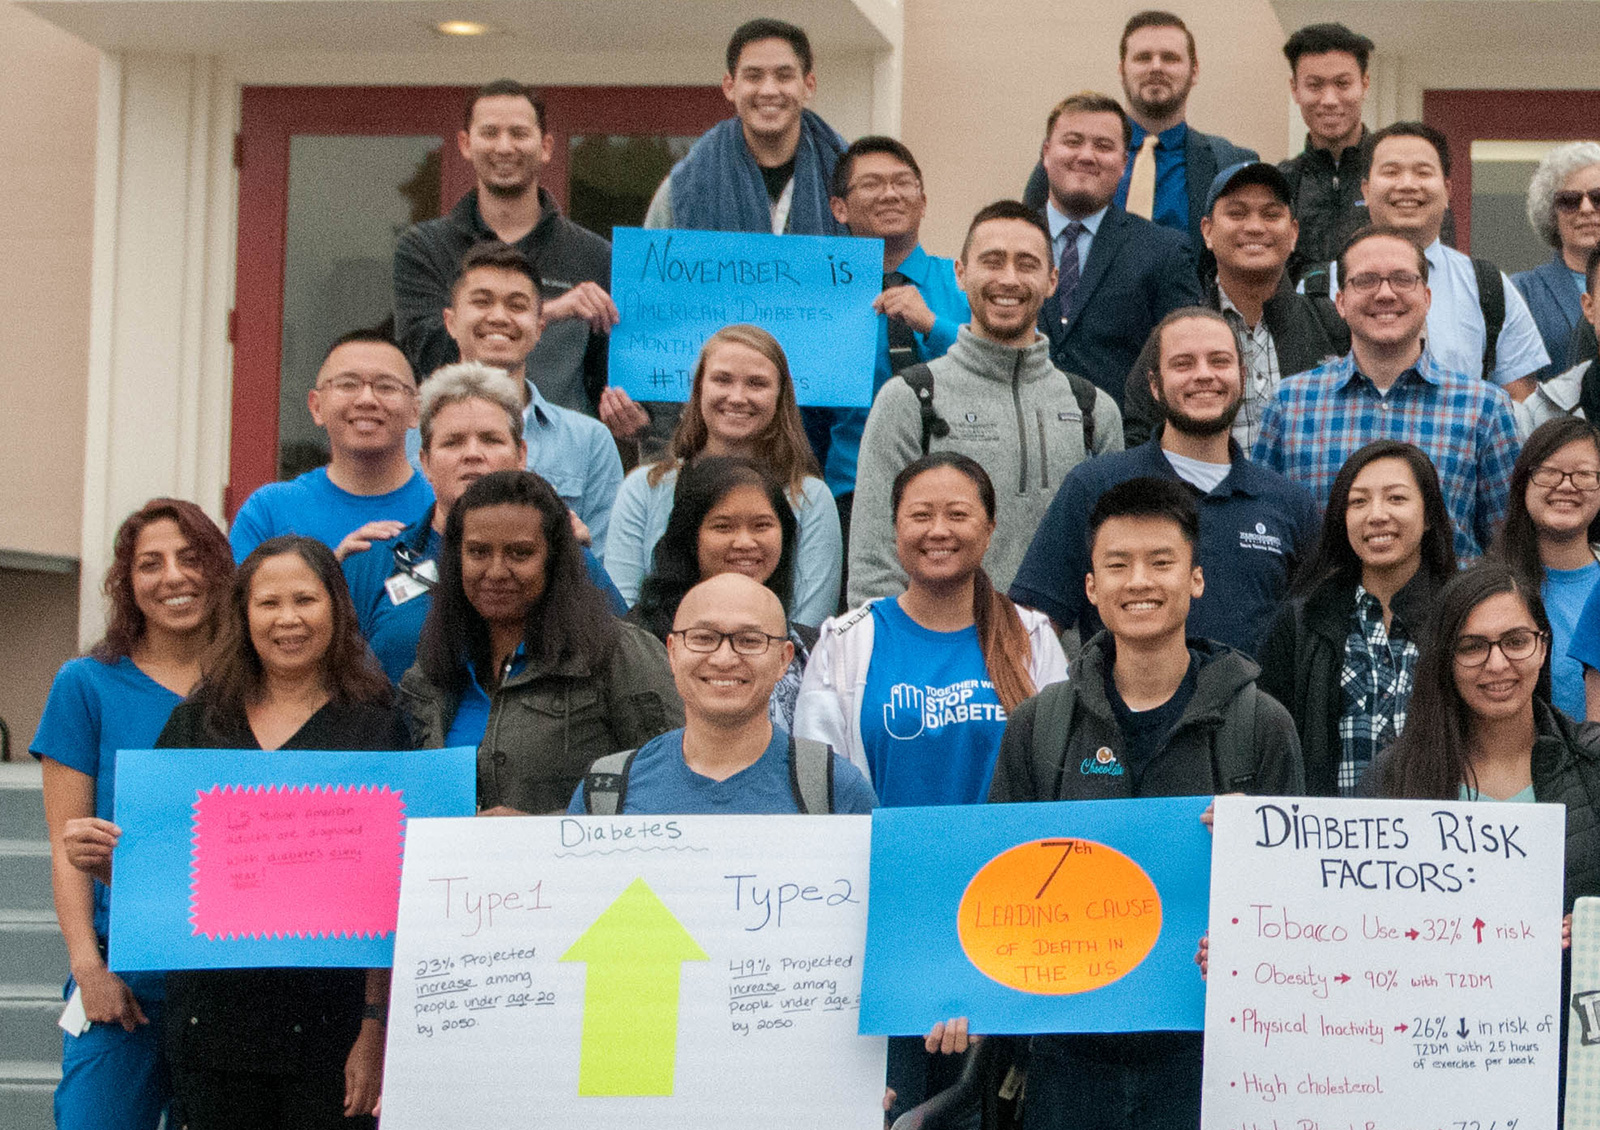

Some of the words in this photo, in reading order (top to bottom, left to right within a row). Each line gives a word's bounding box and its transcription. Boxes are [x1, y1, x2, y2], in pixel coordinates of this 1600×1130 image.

[641, 236, 801, 285] NOVEMBER
[828, 255, 853, 286] is
[623, 289, 727, 322] AMERICAN
[733, 296, 834, 323] DIABETES
[925, 679, 978, 697] TOGETHER
[926, 689, 973, 713] STOP
[926, 703, 1008, 729] DIABETE
[560, 818, 683, 848] Diabetes
[1320, 859, 1477, 893] FACTORS:
[975, 901, 1070, 928] LEADING
[1086, 898, 1155, 920] CAUSE
[1250, 905, 1348, 942] Tobacco
[1362, 914, 1400, 940] Use
[1422, 917, 1463, 945] 32%
[1495, 920, 1536, 940] risk
[996, 942, 1018, 956] OF
[1032, 939, 1097, 956] DEATH
[1109, 938, 1124, 951] IN
[416, 957, 455, 977] 23%
[461, 947, 536, 968] Projected
[729, 957, 771, 976] 49%
[781, 955, 853, 972] Projected
[1017, 965, 1067, 983] THE
[416, 977, 478, 994] increase
[485, 970, 533, 988] among
[729, 982, 786, 995] increase
[793, 979, 837, 995] among
[1254, 962, 1328, 999] Obesity
[1363, 970, 1398, 991] 90%
[1411, 974, 1439, 988] with
[1445, 972, 1493, 989] T2DM
[414, 1000, 459, 1017] people
[464, 995, 502, 1008] under
[508, 993, 530, 1006] age
[535, 991, 556, 1003] 20
[780, 996, 818, 1008] under
[824, 996, 851, 1010] age
[416, 1023, 434, 1038] by
[732, 1021, 749, 1036] by
[1242, 1008, 1309, 1047] Physical
[1320, 1014, 1384, 1045] Inactivity
[1412, 1016, 1449, 1040] 26%
[1478, 1019, 1493, 1035] in
[1498, 1016, 1530, 1034] risk
[1536, 1014, 1554, 1034] of
[1413, 1042, 1449, 1056] T2DM
[1456, 1041, 1483, 1054] with
[1510, 1041, 1540, 1053] hours
[1413, 1058, 1426, 1070] of
[1432, 1058, 1477, 1069] exercise
[1485, 1058, 1501, 1071] per
[1508, 1056, 1535, 1066] week
[1243, 1072, 1287, 1102] High
